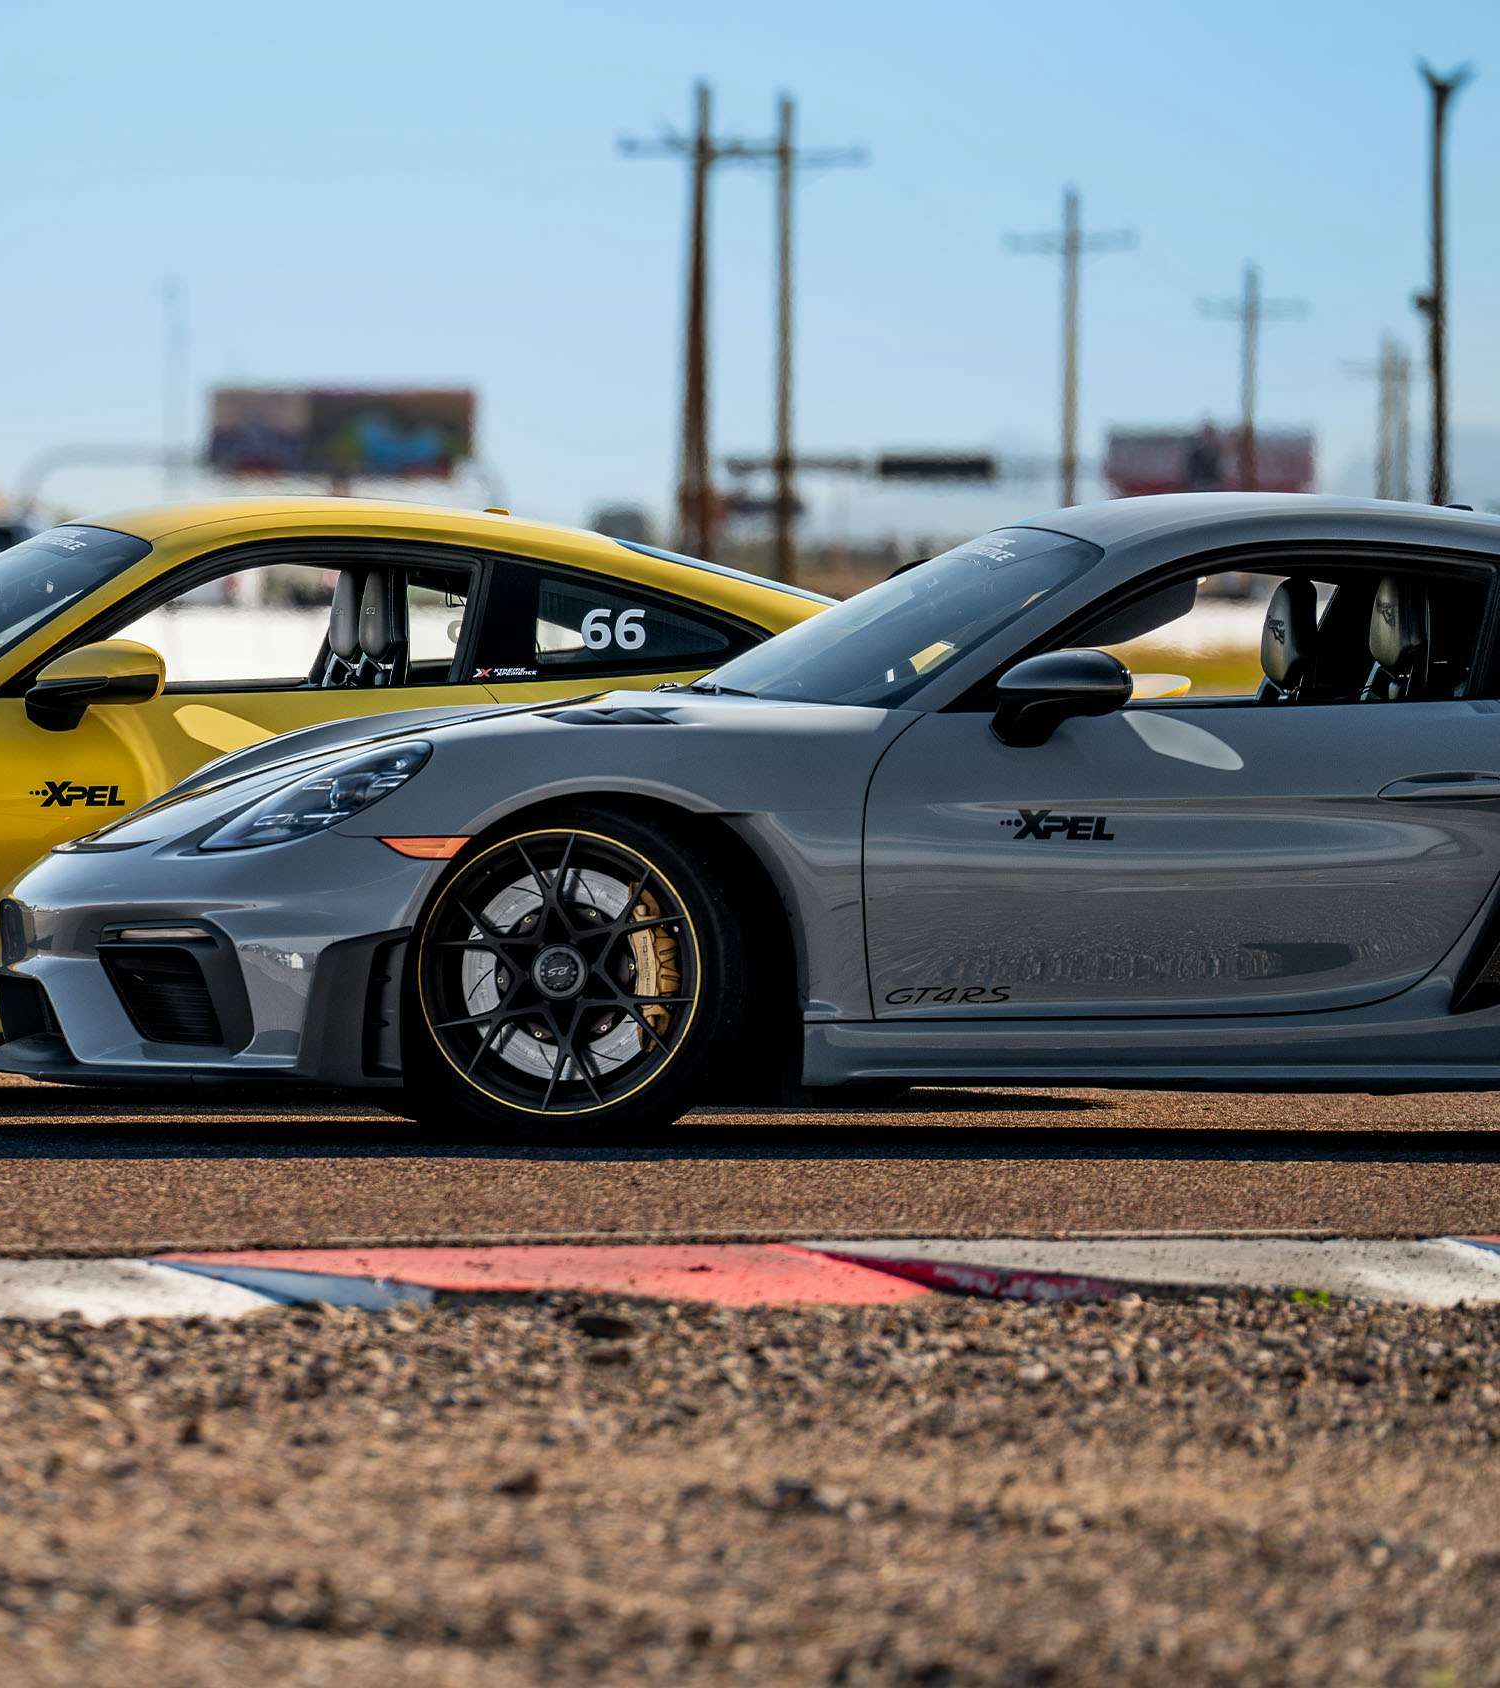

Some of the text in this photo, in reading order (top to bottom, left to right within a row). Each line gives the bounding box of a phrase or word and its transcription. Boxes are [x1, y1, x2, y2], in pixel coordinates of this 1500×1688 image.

[581, 609, 646, 650] 66
[40, 781, 126, 807] XPEL
[1013, 809, 1115, 840] XPEL
